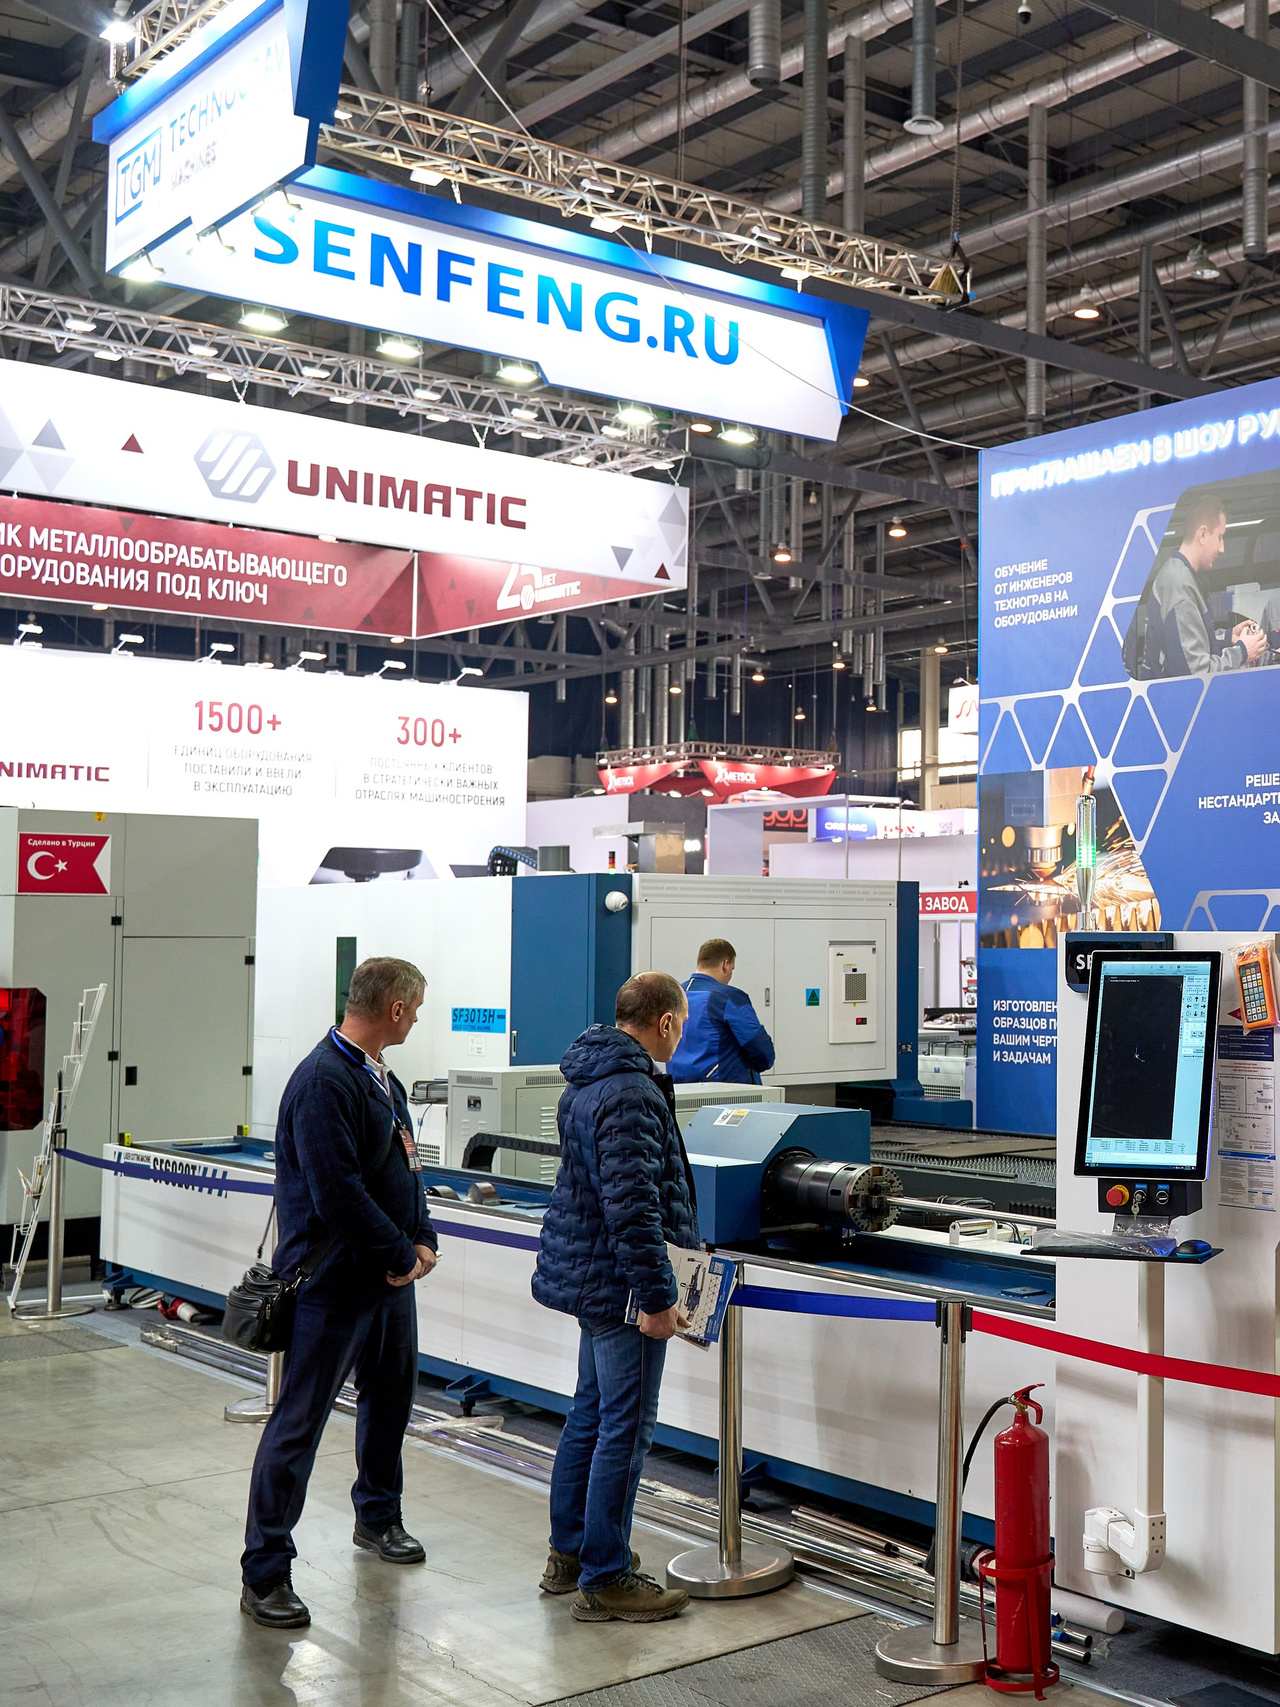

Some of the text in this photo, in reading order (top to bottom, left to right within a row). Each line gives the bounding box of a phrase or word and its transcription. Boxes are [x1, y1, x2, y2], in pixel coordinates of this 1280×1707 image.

[253, 214, 740, 366] SENFENG.RU
[1152, 434, 1172, 463] В
[1173, 418, 1235, 458] ШОУ
[287, 459, 527, 530] UNIMATIC
[29, 525, 348, 587] МЕТАЛЛООБРАБАТЫВАЮЩЕГО
[994, 558, 1048, 579] ОБУЧЕНИЕ
[156, 571, 202, 601] ПОД
[207, 576, 268, 605] КЛЮЧ
[994, 571, 1073, 595] ОТ ИНЖЕНЕРОВ
[994, 589, 1069, 612] ТЕХНОГРАВ НА
[994, 604, 1078, 628] ОБОРУДОВАНИИ
[194, 700, 282, 735] 1500+
[397, 716, 462, 747] 300+
[174, 745, 312, 763] ЕДИНИЦ ОБОРУДОВАНИЯ
[184, 763, 302, 780] ПОСТАВИЛИ И ВВЕЛИ
[442, 762, 493, 775] КЛИЕНТОВ
[725, 771, 757, 783] METSOL
[194, 781, 293, 797] В ЭКСПЛУАТАЦИЮ
[363, 773, 370, 783] В
[456, 779, 499, 790] ВАЖНЫХ
[355, 789, 505, 807] ОТРАСЛЯХ МАШИНОСТРОЕНИЯ
[27, 837, 60, 849] Сделано
[67, 839, 96, 849] Турции
[925, 896, 969, 912] ЗАВОД
[993, 1000, 1057, 1013] ИЗГОТОВЛЕН
[452, 1008, 496, 1024] SF3015H
[993, 1016, 1047, 1031] ОБРАЗЦОВ
[993, 1033, 1030, 1046] ВАШИМ
[993, 1050, 1051, 1064] И ЗАДАЧАМ
